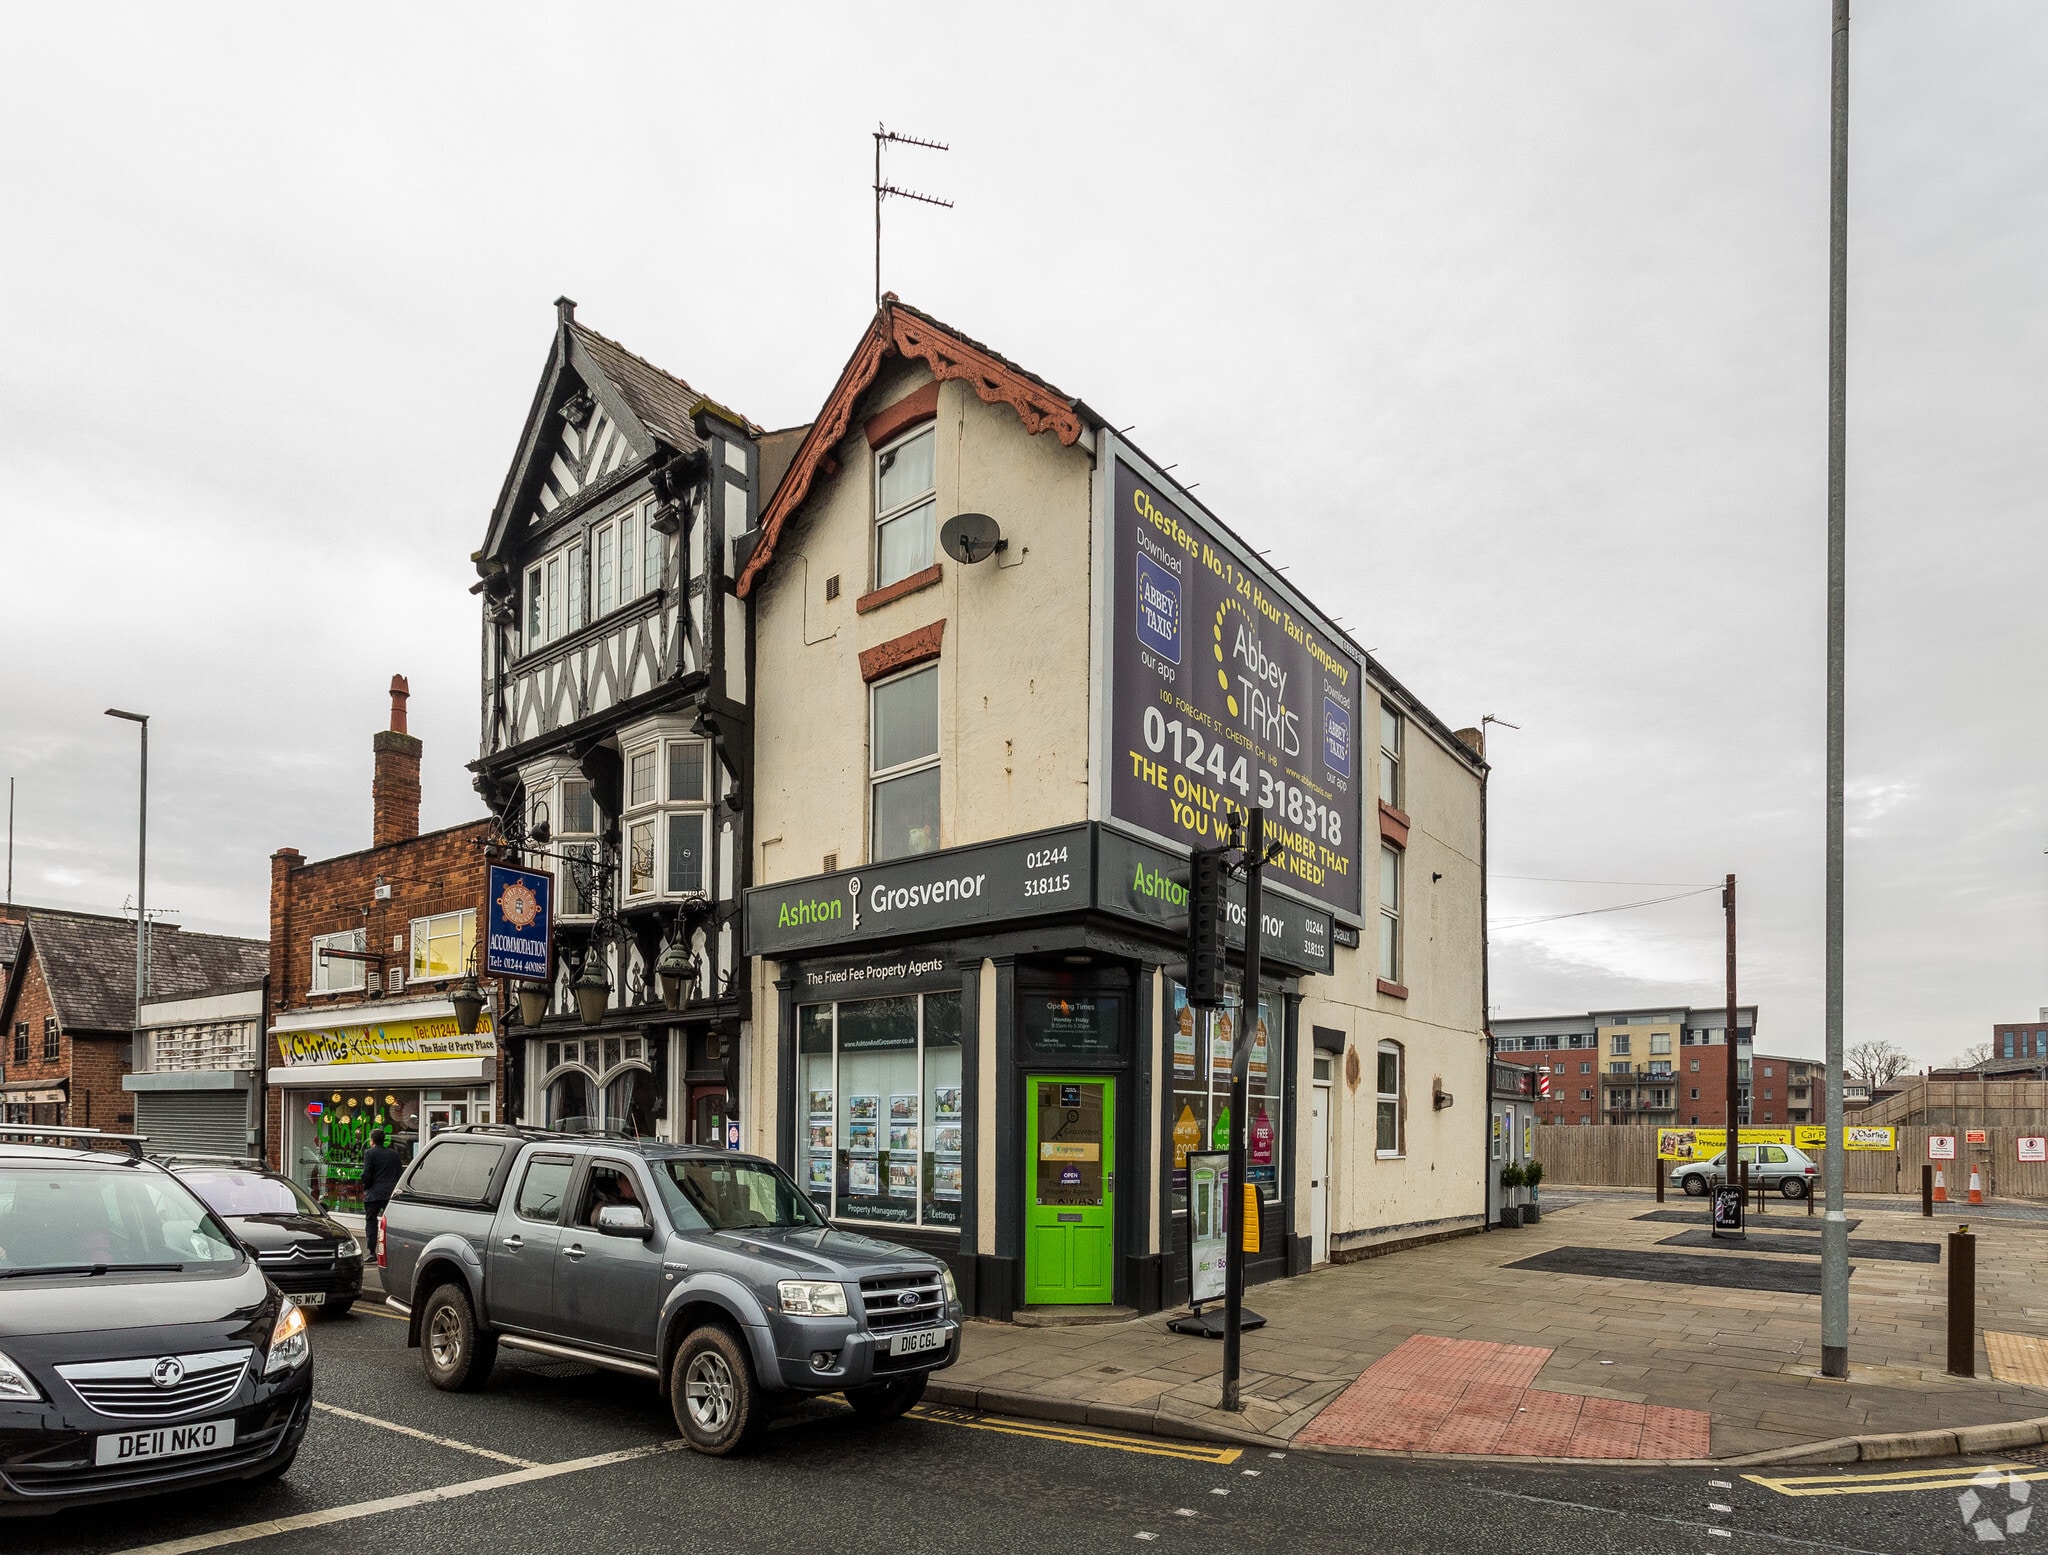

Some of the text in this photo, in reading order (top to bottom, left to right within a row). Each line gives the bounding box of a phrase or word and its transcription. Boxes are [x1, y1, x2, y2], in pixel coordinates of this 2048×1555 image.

[1137, 527, 1182, 574] Download
[1134, 489, 1198, 558] Chesters
[1202, 544, 1232, 584] No.1
[1237, 572, 1250, 600] 24
[1254, 587, 1281, 625] Hour
[1283, 613, 1303, 645] Taxi
[1306, 633, 1349, 686] Company
[1144, 582, 1174, 618] ABBEY
[1145, 607, 1172, 641] TAXIS
[1141, 651, 1176, 683] our app
[1233, 624, 1288, 703] Abbey
[1324, 679, 1350, 709] Download
[1160, 688, 1173, 705] 100
[1176, 697, 1211, 728] FOREGATE
[1225, 727, 1254, 752] CHESTER
[1328, 718, 1347, 743] ABBEY
[1329, 738, 1346, 761] TAXIS
[1143, 706, 1342, 846] 01244 318318
[1327, 772, 1347, 793] our app
[1129, 750, 1168, 791] THE
[1173, 773, 1219, 813] ONLY
[1264, 818, 1317, 862] NUMBER
[1319, 846, 1349, 876] THAT
[1170, 799, 1208, 835] YOU
[1289, 854, 1325, 887] NEED!
[1027, 846, 1068, 869] 01244
[1024, 874, 1070, 897] 318115
[778, 898, 842, 928] Ashton
[871, 874, 986, 913] Grosvenor
[1305, 919, 1323, 936] 01244
[490, 933, 546, 957] ACCOMMODATION
[1304, 940, 1325, 958] 318115
[490, 955, 502, 967] Tel:
[503, 957, 523, 971] 01244
[807, 958, 943, 985] The Fixed Fee Property Agents
[1047, 1002, 1075, 1011] Opening
[414, 1024, 430, 1039] Tel:
[431, 1023, 457, 1038] 01244
[291, 1031, 415, 1063] Charlie's KIDS CUTS
[419, 1039, 494, 1053] The Hair & Party Place
[1257, 1128, 1268, 1138] FREE
[1801, 1131, 1816, 1139] Car
[848, 1203, 956, 1220] Property Management Lettings
[1200, 1261, 1210, 1271] Best
[304, 1294, 324, 1304] WKJ
[903, 1294, 916, 1304] Ford
[920, 1332, 937, 1348] CGL
